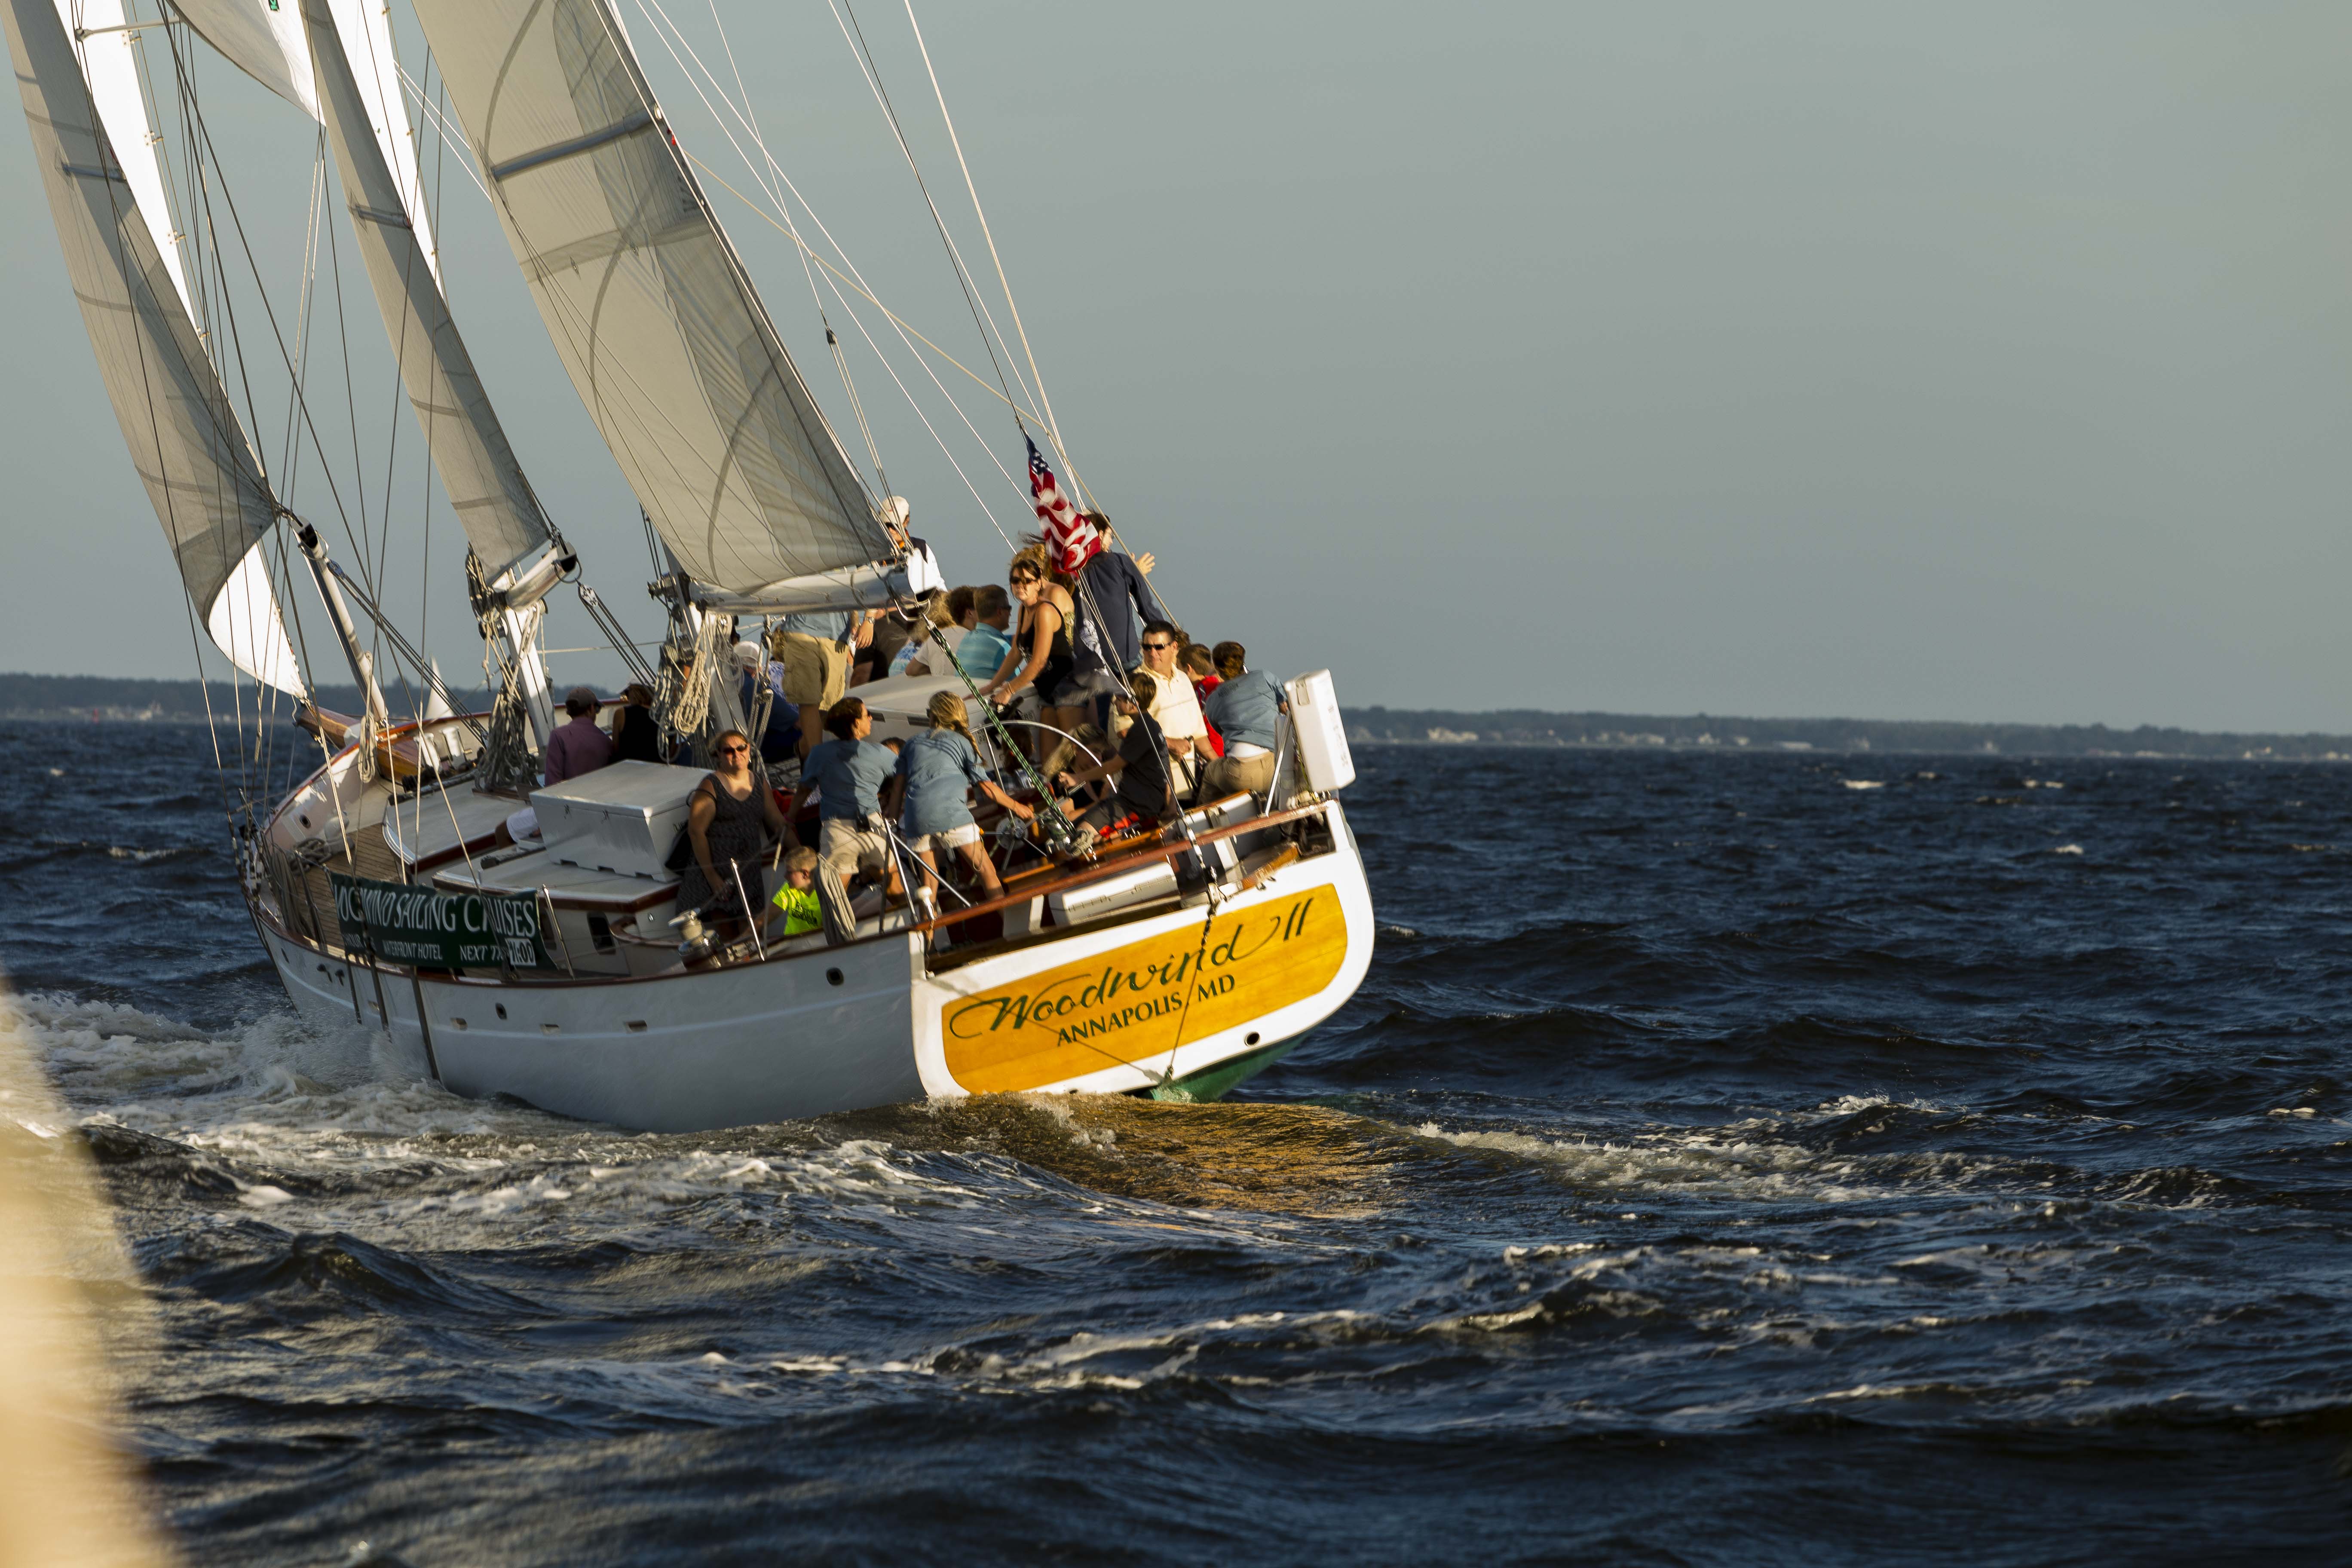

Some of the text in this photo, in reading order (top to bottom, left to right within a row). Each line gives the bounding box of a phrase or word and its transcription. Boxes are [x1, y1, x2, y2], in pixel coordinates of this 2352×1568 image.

[394, 893, 457, 932] SAILING
[417, 942, 443, 960] HOTEL
[459, 945, 487, 961] NEXT
[949, 916, 1280, 1039] Woodwind
[1198, 974, 1234, 1002] MD
